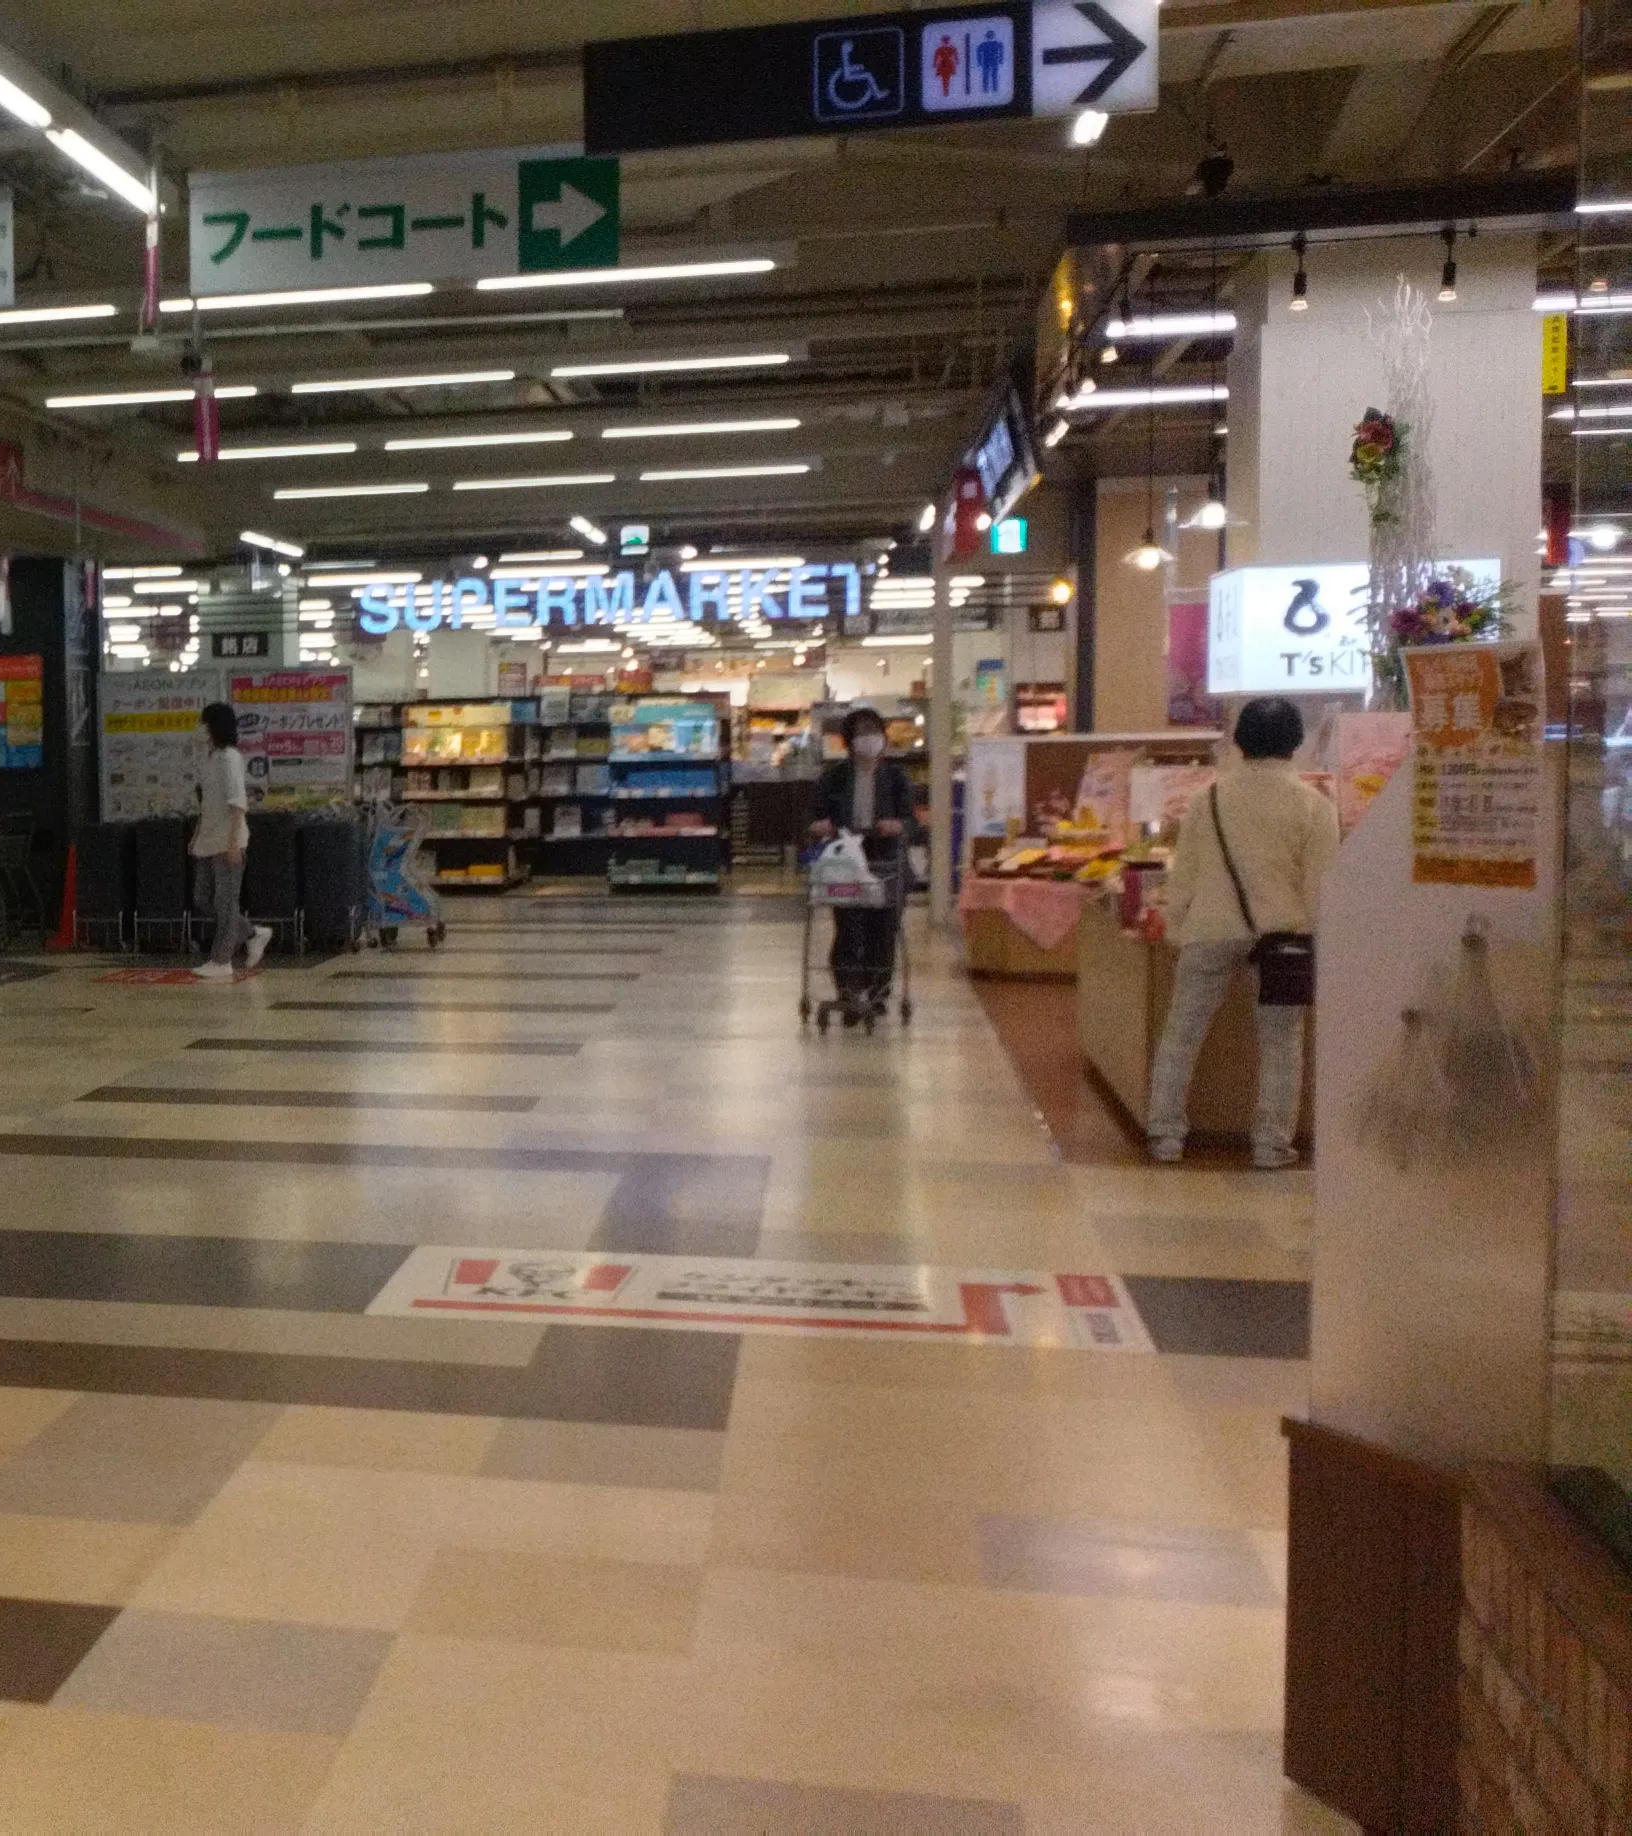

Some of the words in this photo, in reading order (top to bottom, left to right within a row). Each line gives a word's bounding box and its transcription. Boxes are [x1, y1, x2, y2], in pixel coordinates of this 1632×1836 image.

[202, 191, 509, 265] フードコート
[358, 562, 876, 635] SUPERMARKET
